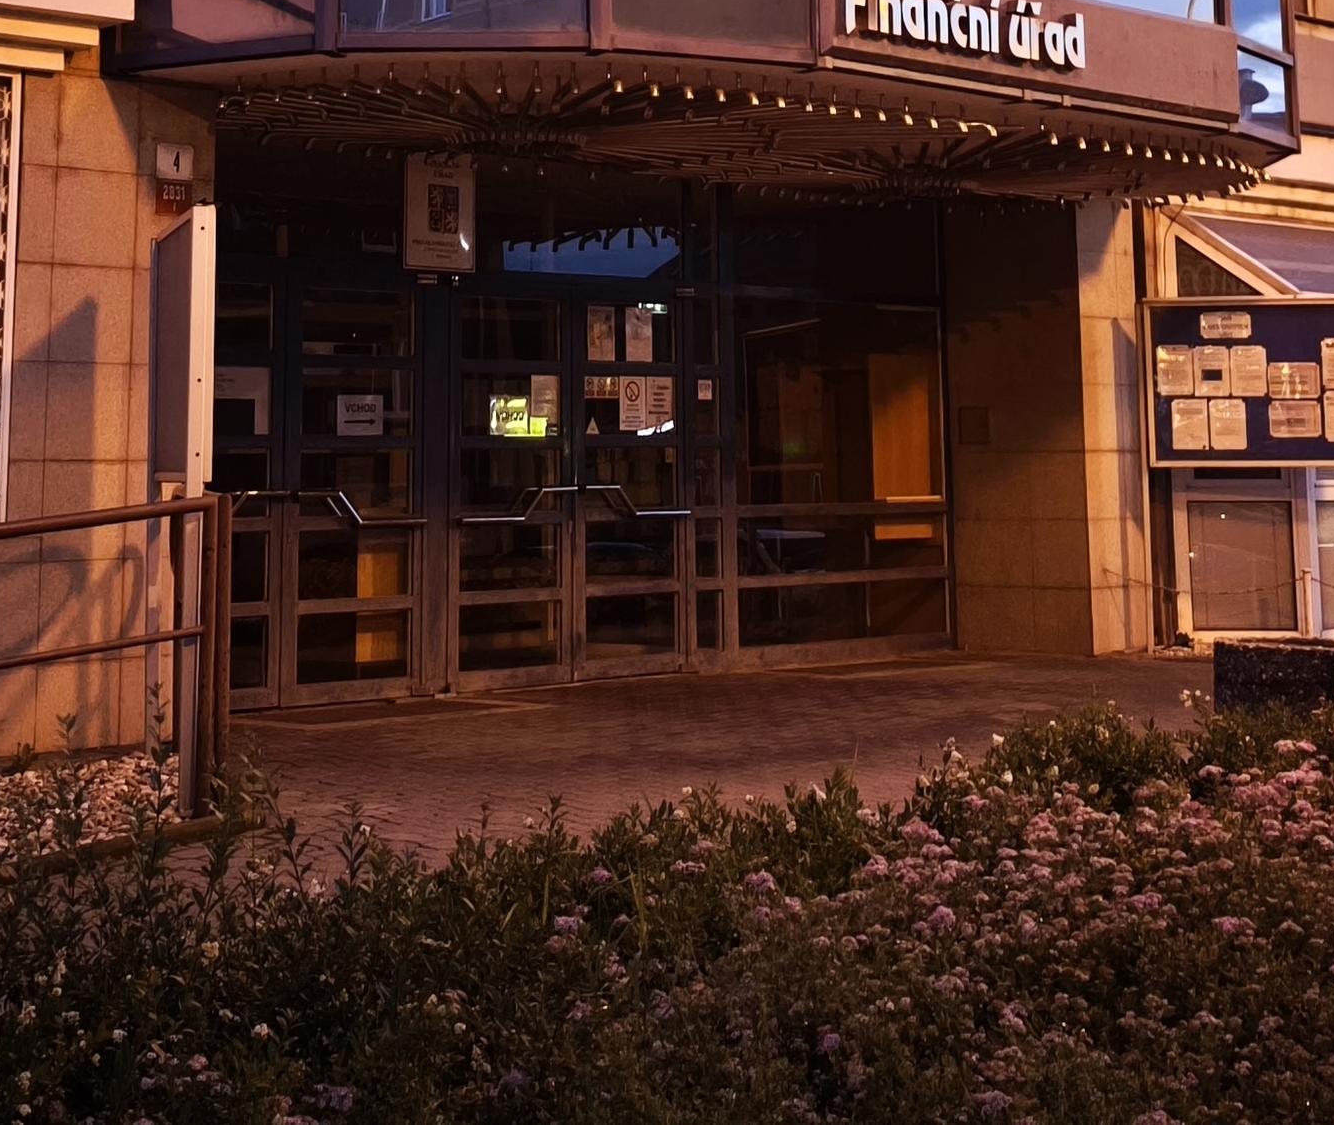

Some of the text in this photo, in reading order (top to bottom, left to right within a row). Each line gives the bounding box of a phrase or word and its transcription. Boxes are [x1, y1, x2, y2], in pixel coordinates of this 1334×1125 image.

[173, 151, 180, 173] 4
[163, 184, 186, 201] 2831
[344, 401, 377, 413] VCHOD
